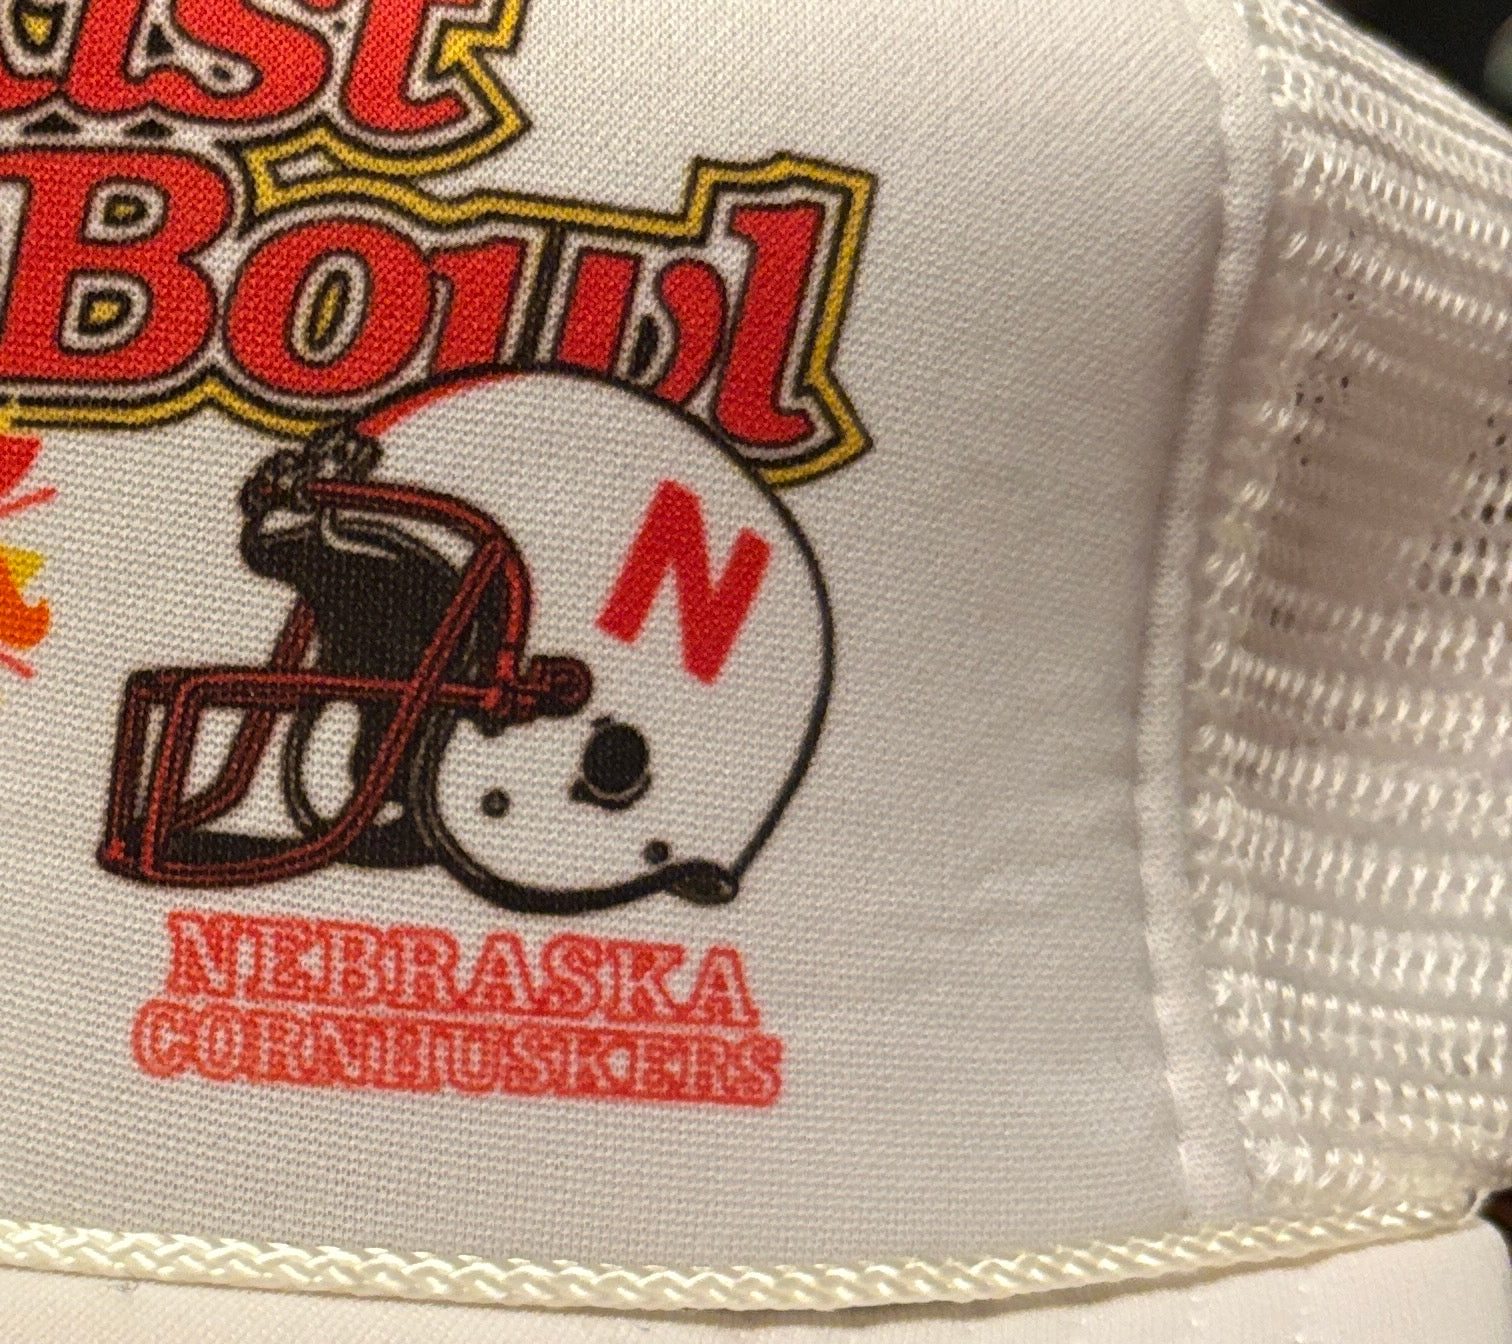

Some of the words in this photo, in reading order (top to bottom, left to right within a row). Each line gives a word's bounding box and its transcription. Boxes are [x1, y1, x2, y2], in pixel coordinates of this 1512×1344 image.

[596, 479, 774, 686] N
[166, 909, 760, 1028] NEBRASKA
[130, 998, 786, 1108] CORNHUSKERS
